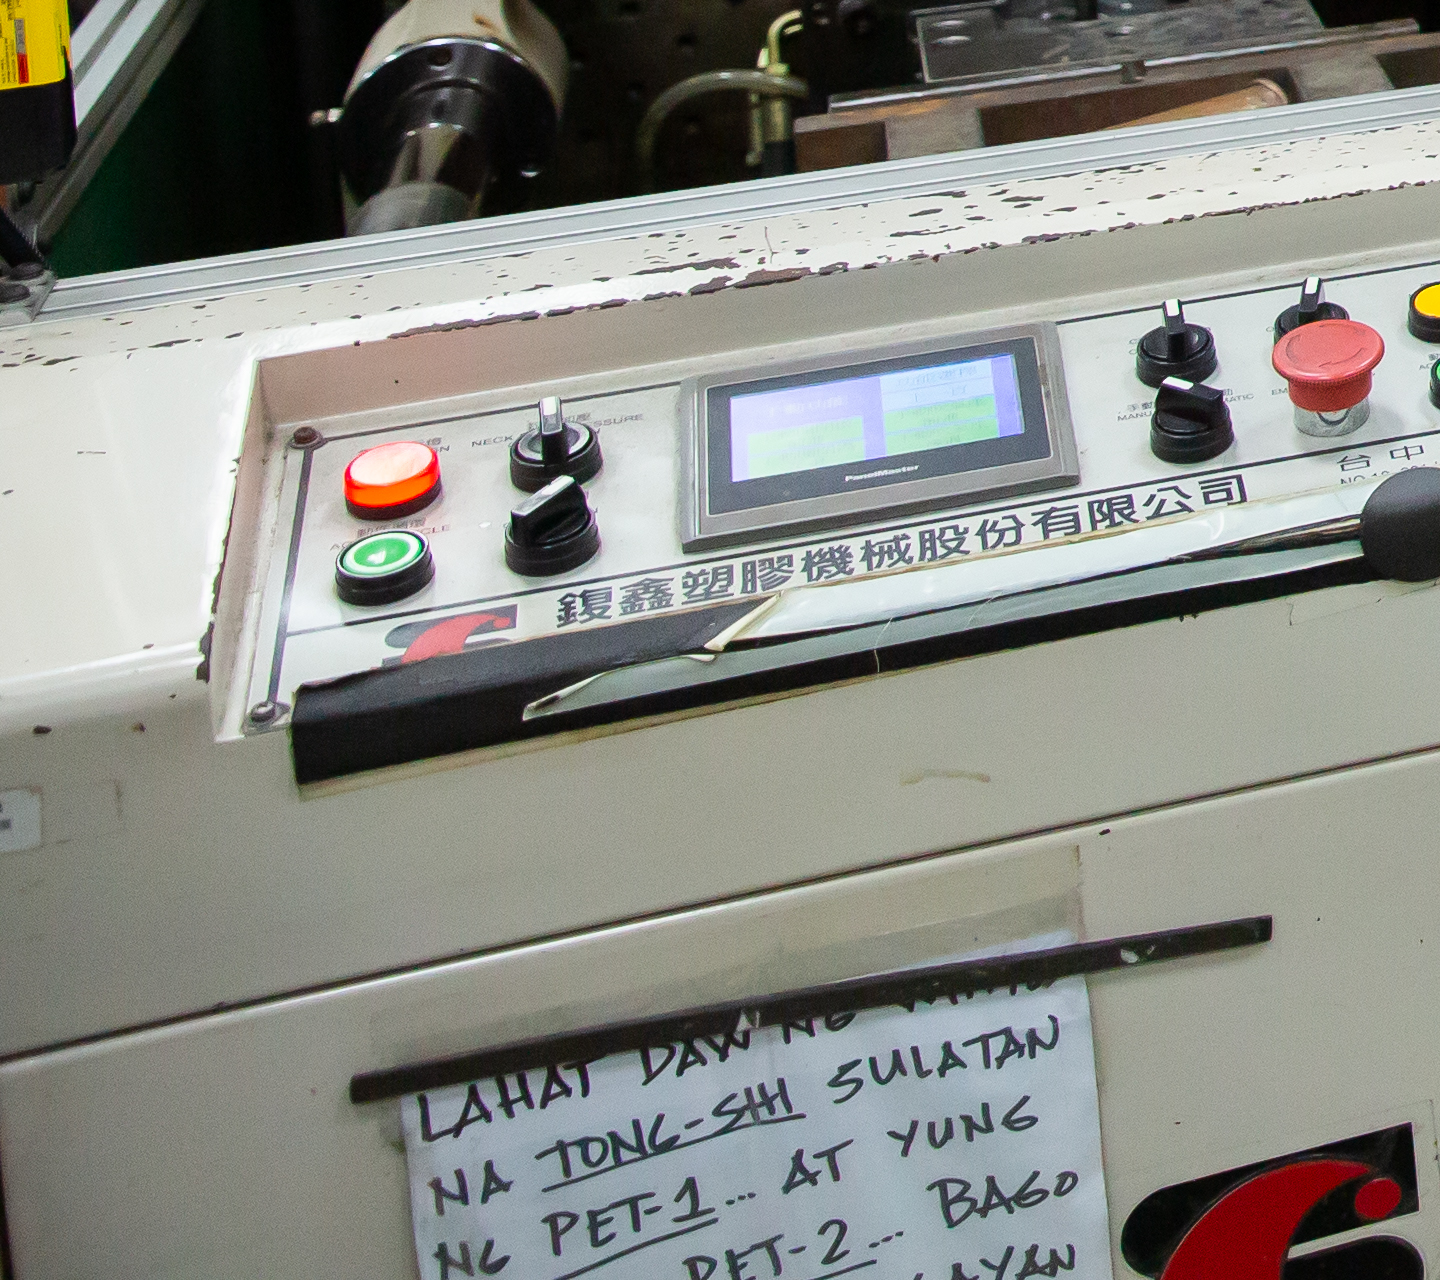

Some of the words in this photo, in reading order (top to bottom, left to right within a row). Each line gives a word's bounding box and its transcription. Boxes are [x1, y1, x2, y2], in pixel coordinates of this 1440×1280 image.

[472, 435, 514, 447] NECK
[844, 464, 920, 482] PanelMaster
[418, 1058, 595, 1140] LAHAT
[640, 1026, 750, 1085] DAW
[429, 1159, 513, 1215] NA
[535, 1078, 806, 1180] TONG-SHI
[827, 1015, 1060, 1105] SULATAN
[433, 1240, 512, 1280] NG
[781, 1141, 853, 1194] AT
[886, 1096, 1039, 1158] YUNG
[925, 1169, 1079, 1228] BAGO
